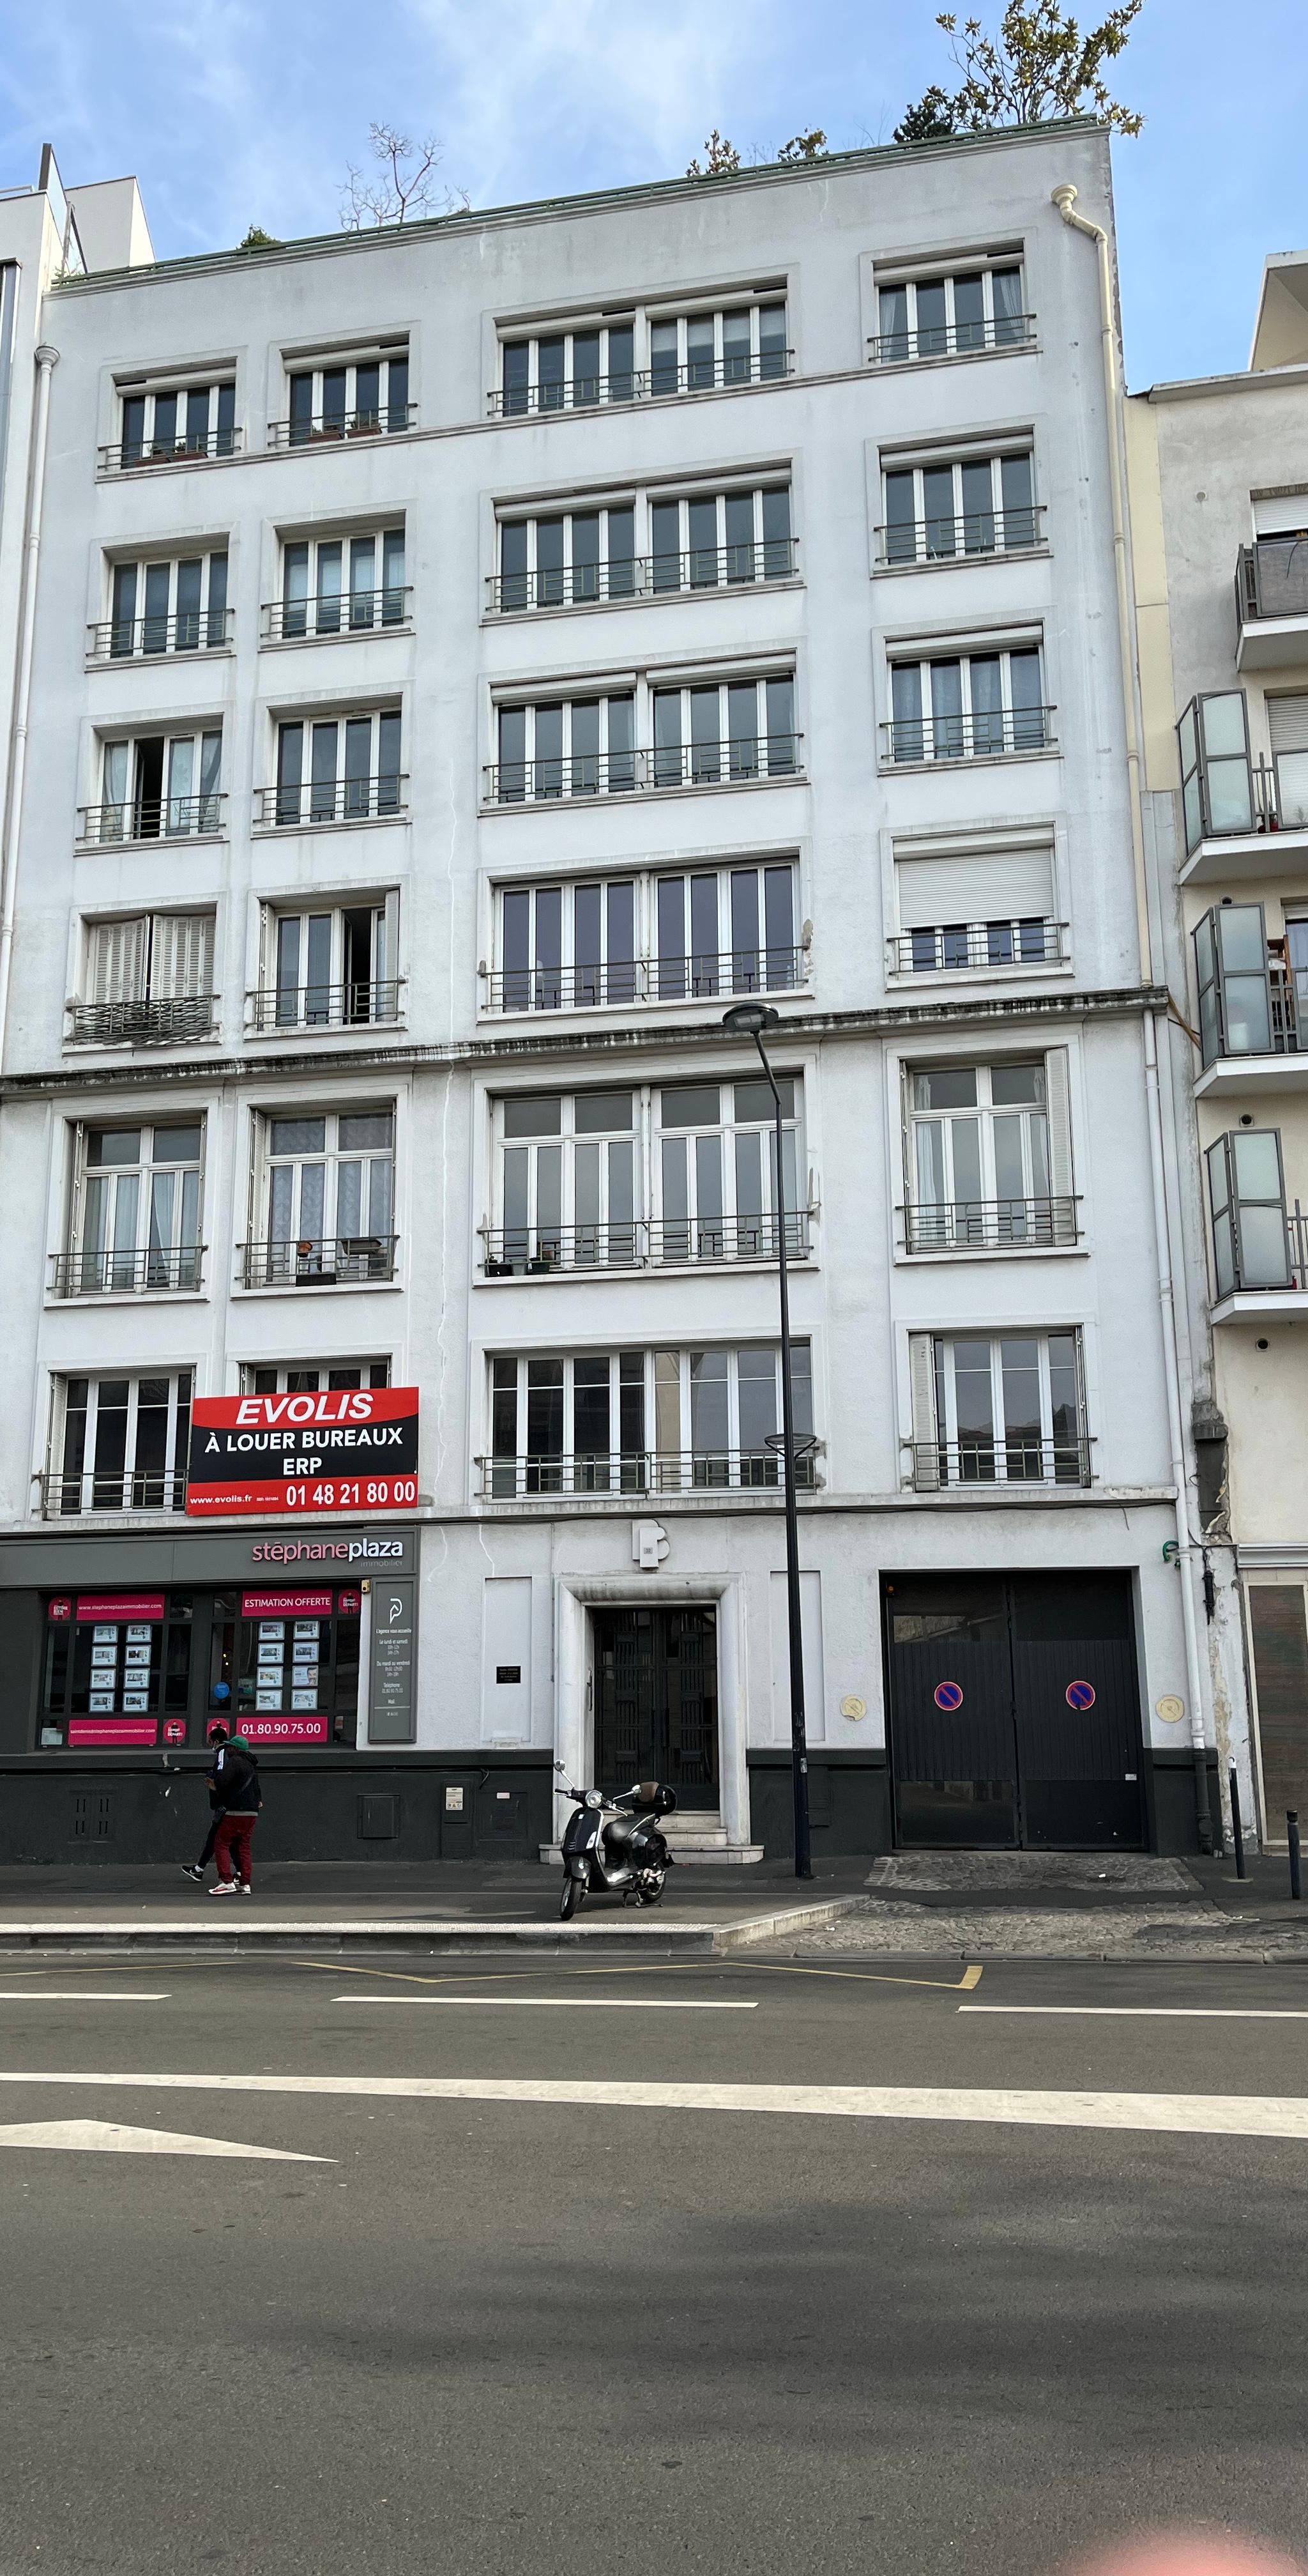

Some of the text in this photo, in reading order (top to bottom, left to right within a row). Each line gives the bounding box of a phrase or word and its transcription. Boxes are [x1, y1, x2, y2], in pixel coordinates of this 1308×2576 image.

[235, 1393, 374, 1425] EVOLIS
[204, 1427, 404, 1453] À LOUER BUREAUX
[283, 1457, 323, 1476] ERP
[190, 1481, 416, 1506] www.evolis.fr 01 48 21 80 00
[245, 1598, 294, 1608] ESTIMATION
[294, 1597, 331, 1607] OFFERTE
[241, 1723, 321, 1735] 01.80.90.75.00
